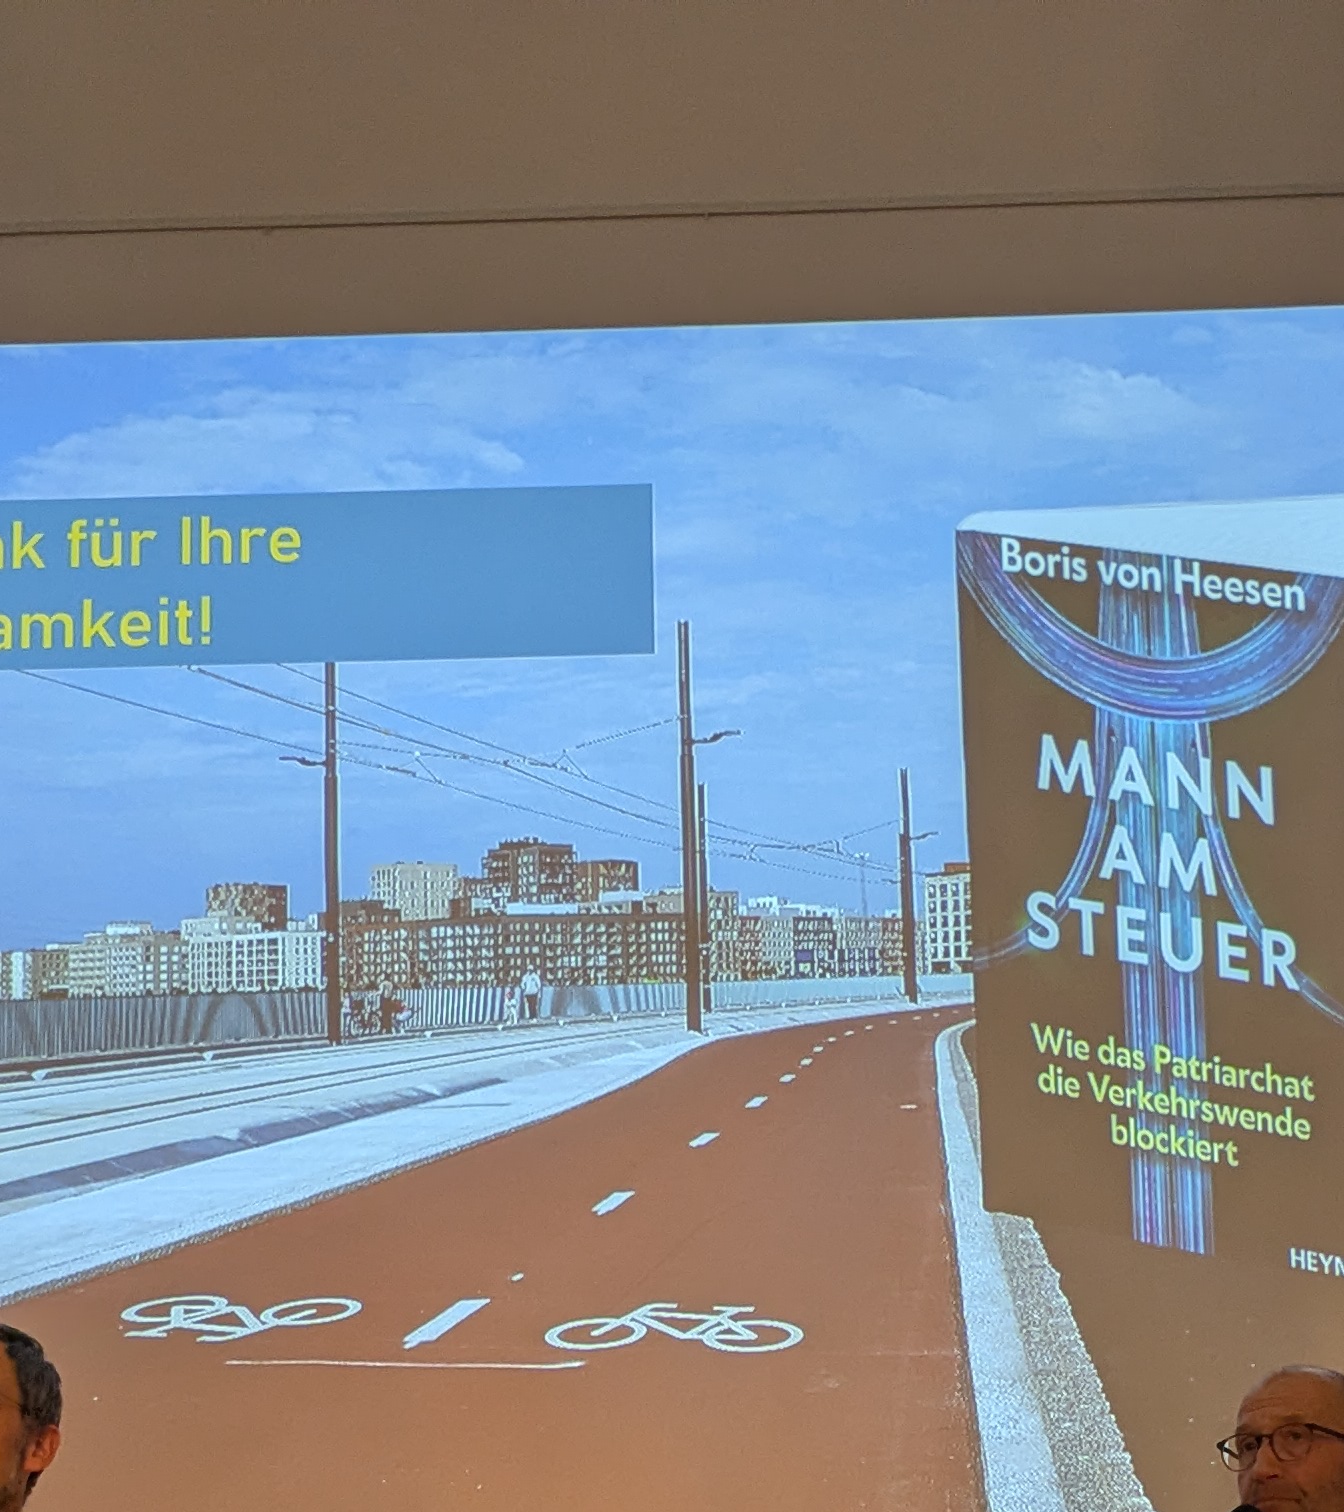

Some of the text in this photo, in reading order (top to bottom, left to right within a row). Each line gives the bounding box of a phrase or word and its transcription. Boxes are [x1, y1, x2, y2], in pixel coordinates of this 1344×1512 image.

[66, 517, 156, 569] für
[180, 515, 302, 565] Ihre
[999, 536, 1307, 612] Boris von Heesen
[1037, 733, 1275, 826] MANN
[1099, 825, 1218, 897] AM
[1026, 891, 1300, 991] STEUER
[1030, 1021, 1316, 1102] Wie das Patriarchat
[1037, 1063, 1311, 1141] die Verkehrswende
[1110, 1113, 1239, 1167] blockiert
